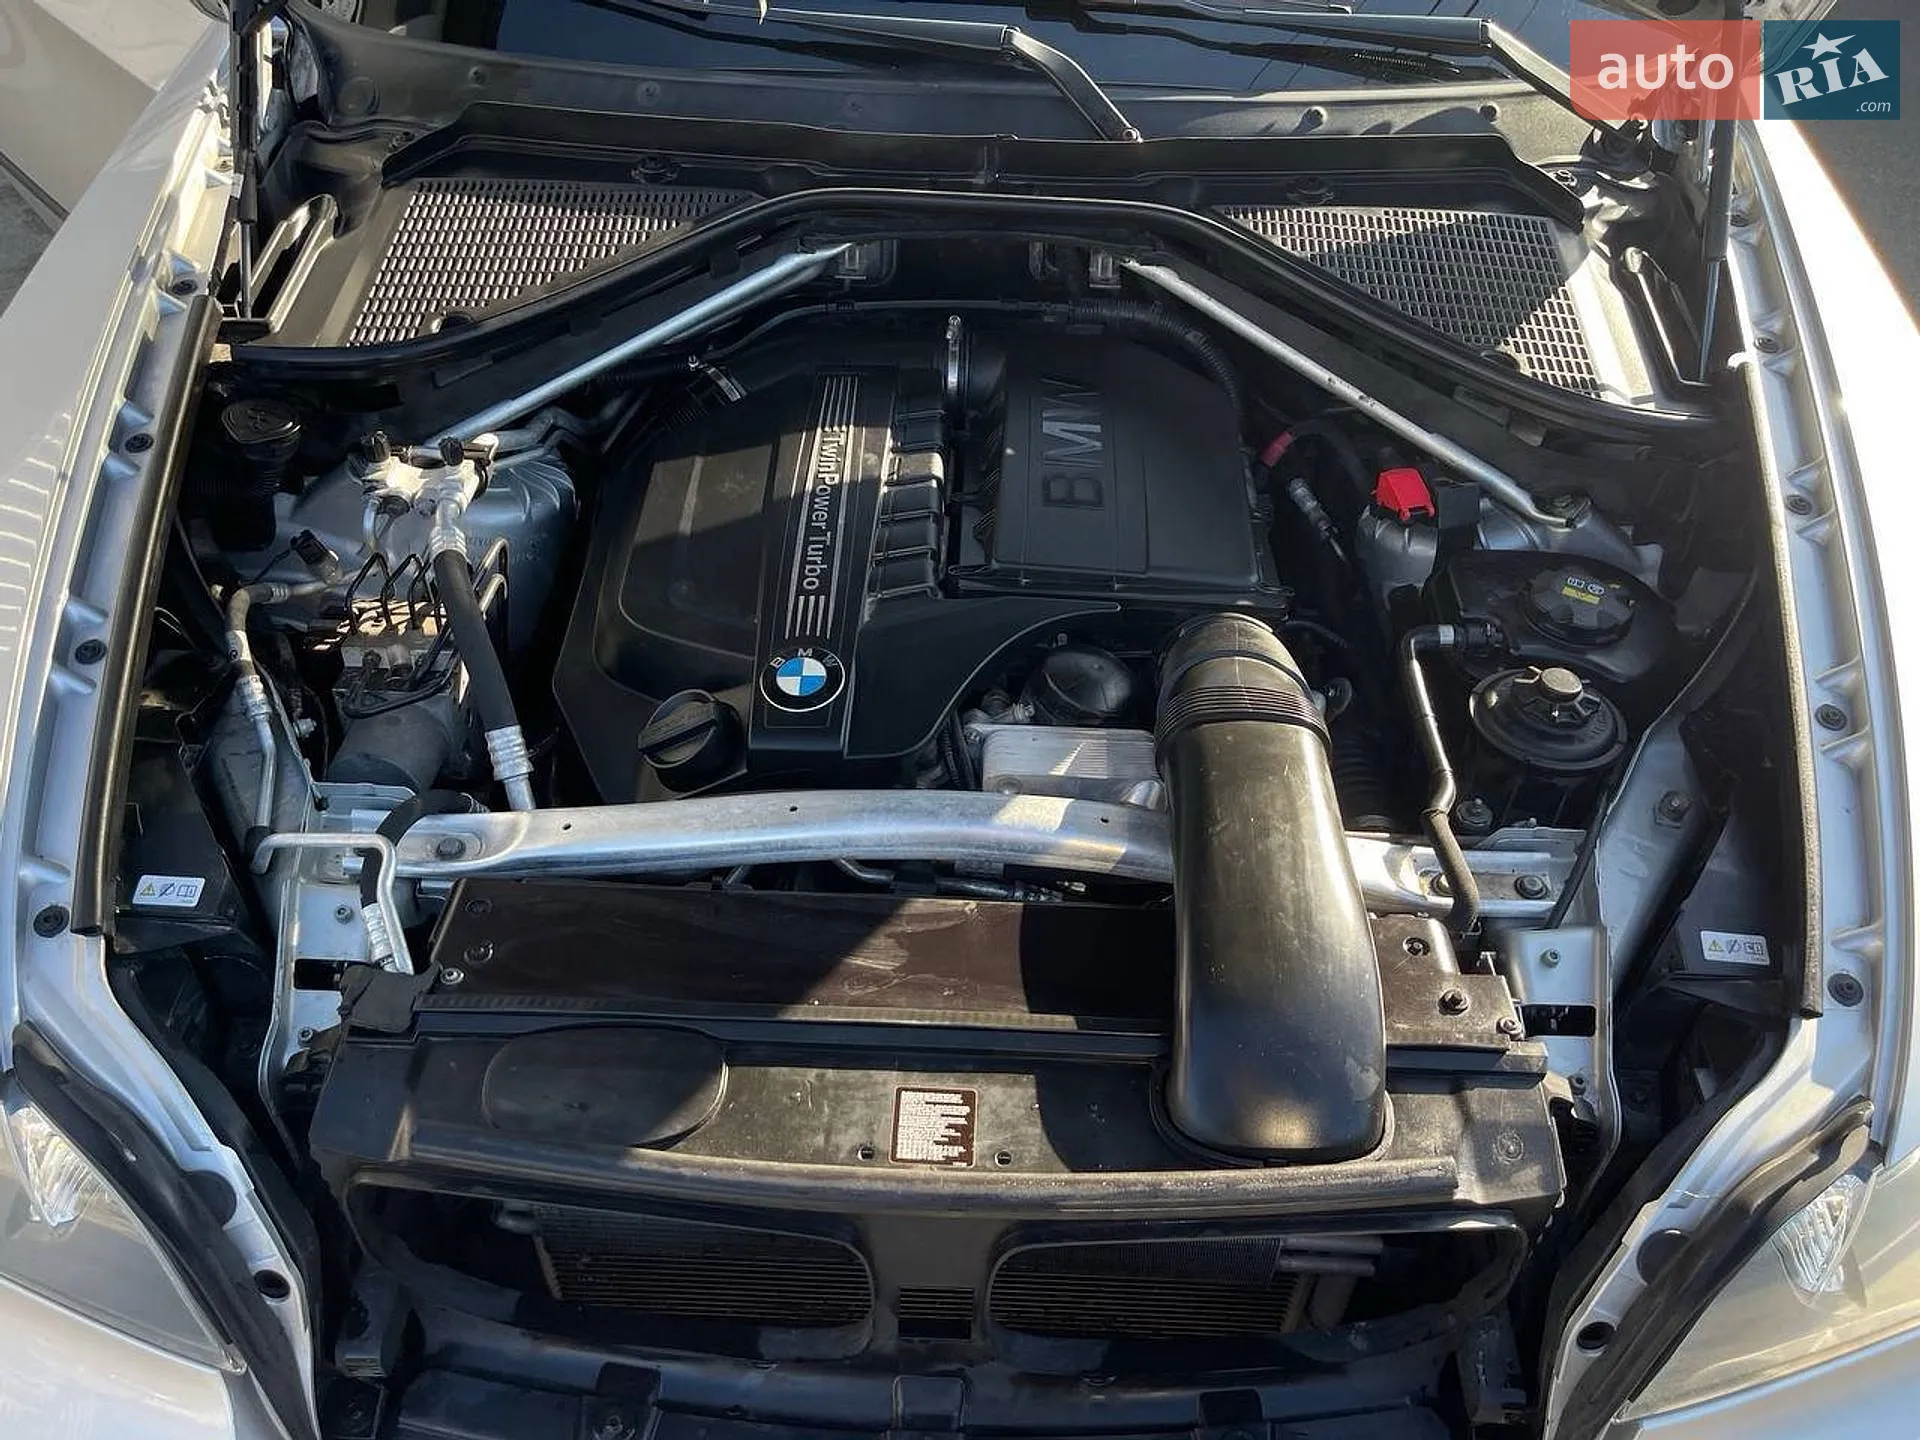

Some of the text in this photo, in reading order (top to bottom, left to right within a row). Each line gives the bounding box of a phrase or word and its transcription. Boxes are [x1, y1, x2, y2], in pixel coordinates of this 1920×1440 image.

[1042, 376, 1104, 510] BMW
[803, 431, 846, 591] TwinPower Turbo
[769, 647, 839, 669] BMW
